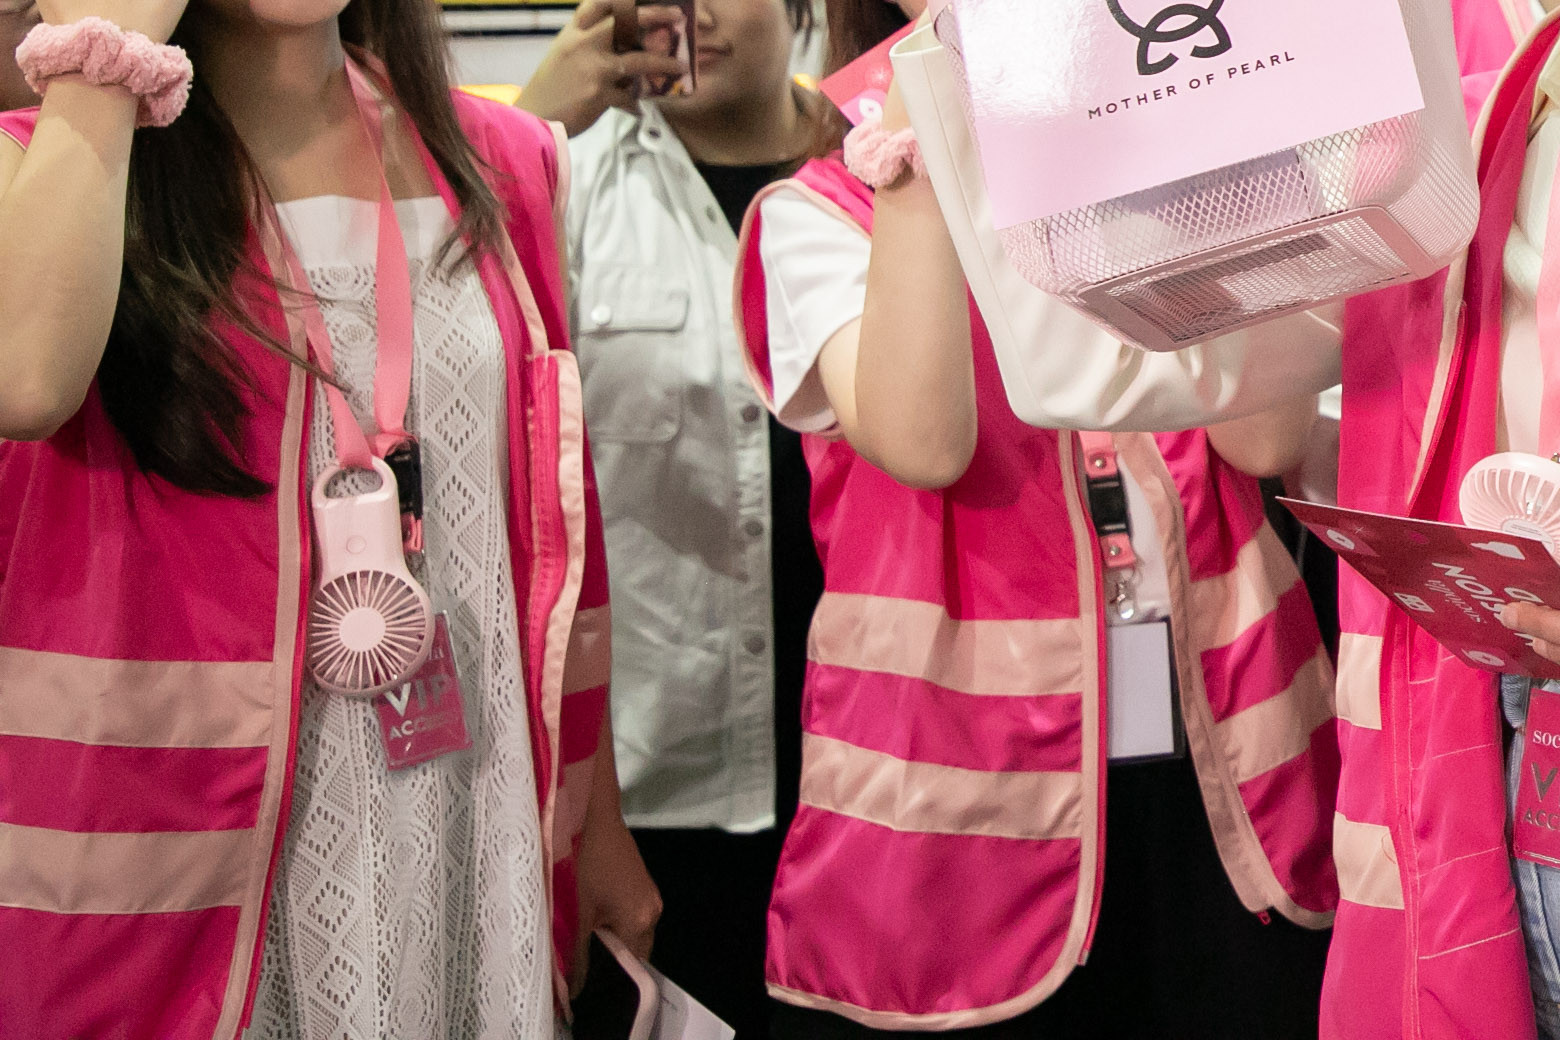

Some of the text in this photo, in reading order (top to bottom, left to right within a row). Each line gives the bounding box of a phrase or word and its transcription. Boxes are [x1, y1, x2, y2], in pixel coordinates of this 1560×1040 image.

[1088, 50, 1296, 120] MOTHER OF PEARL
[384, 672, 451, 718] VIP
